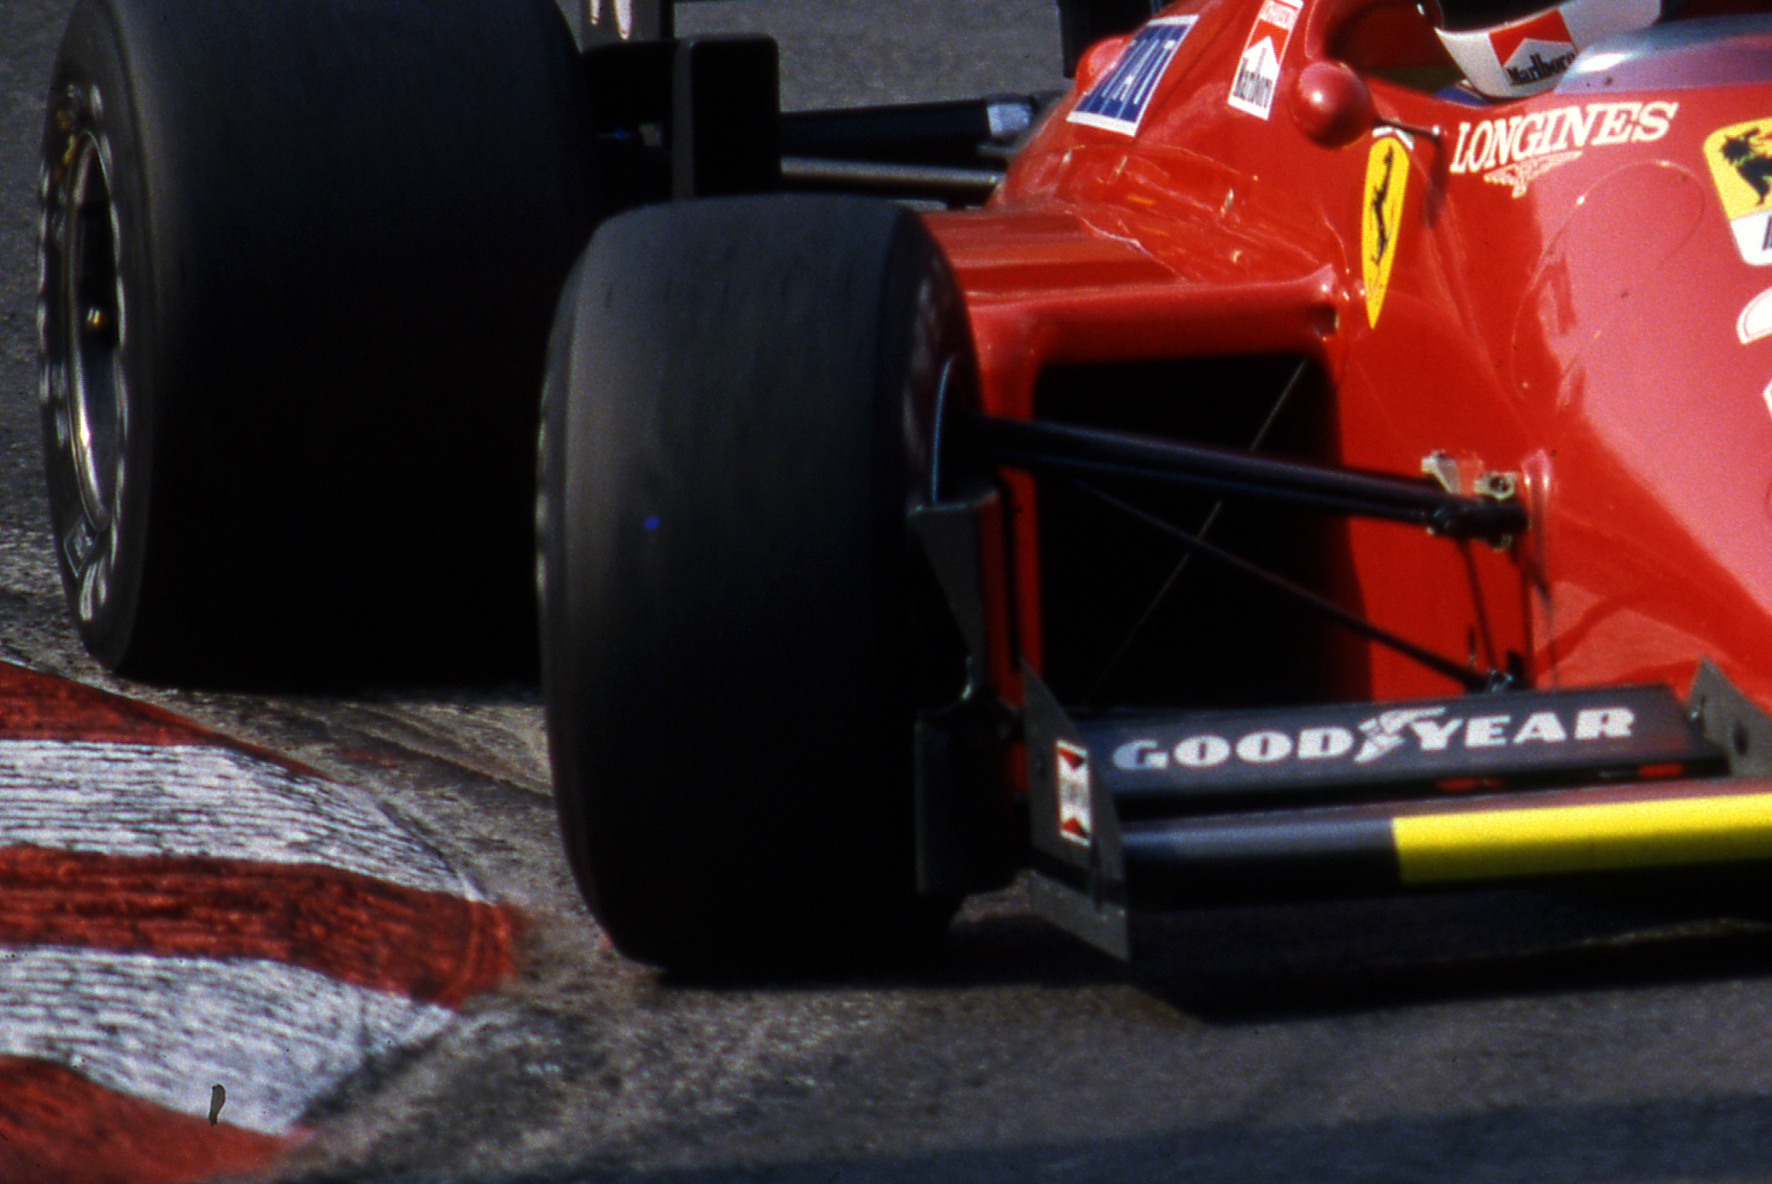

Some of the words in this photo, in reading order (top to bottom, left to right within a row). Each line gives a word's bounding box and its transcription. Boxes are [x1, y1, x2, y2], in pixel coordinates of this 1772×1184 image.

[1506, 51, 1577, 87] Marlboro
[1450, 101, 1679, 174] LONGINES
[1112, 707, 1636, 772] GOODYEAR
